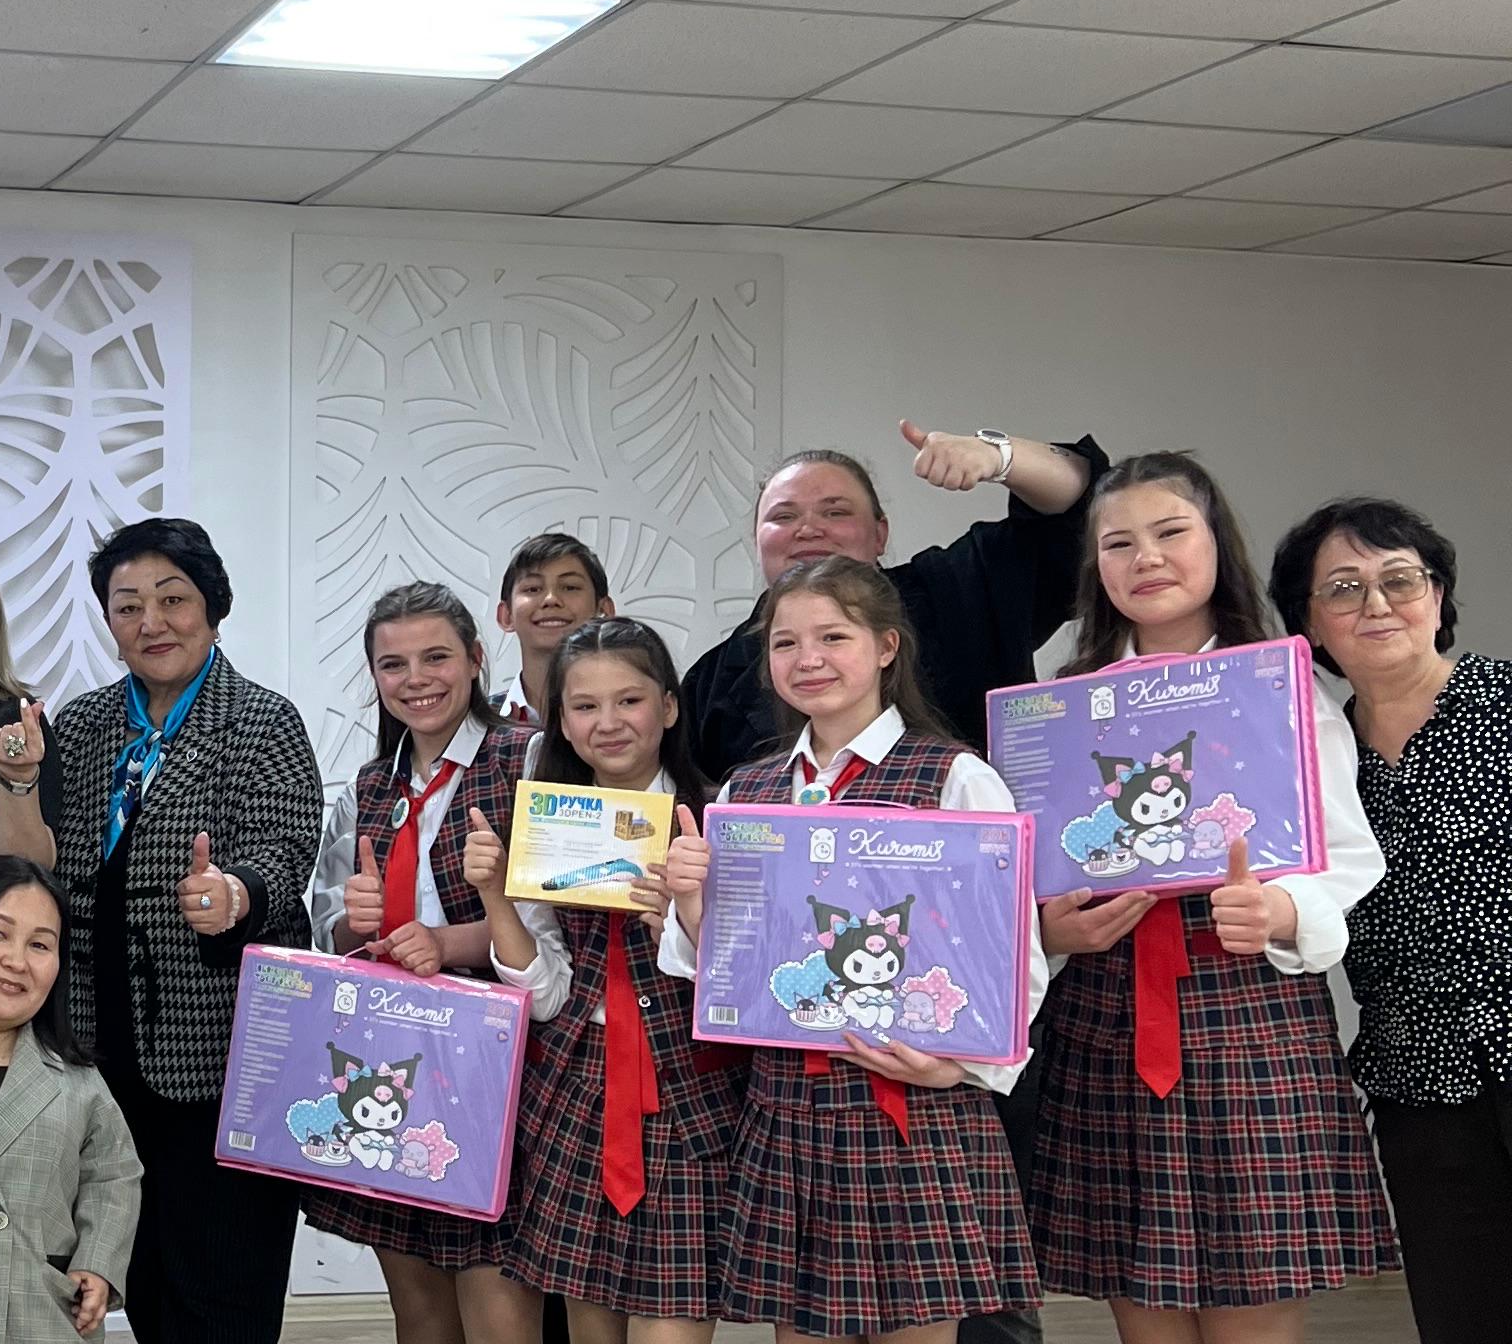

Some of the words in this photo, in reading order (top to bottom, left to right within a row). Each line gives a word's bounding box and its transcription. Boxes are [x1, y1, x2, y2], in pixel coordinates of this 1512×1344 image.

[529, 792, 558, 816] 3D
[559, 794, 603, 811] РУЧКА
[558, 808, 602, 819] 3DPEN-2
